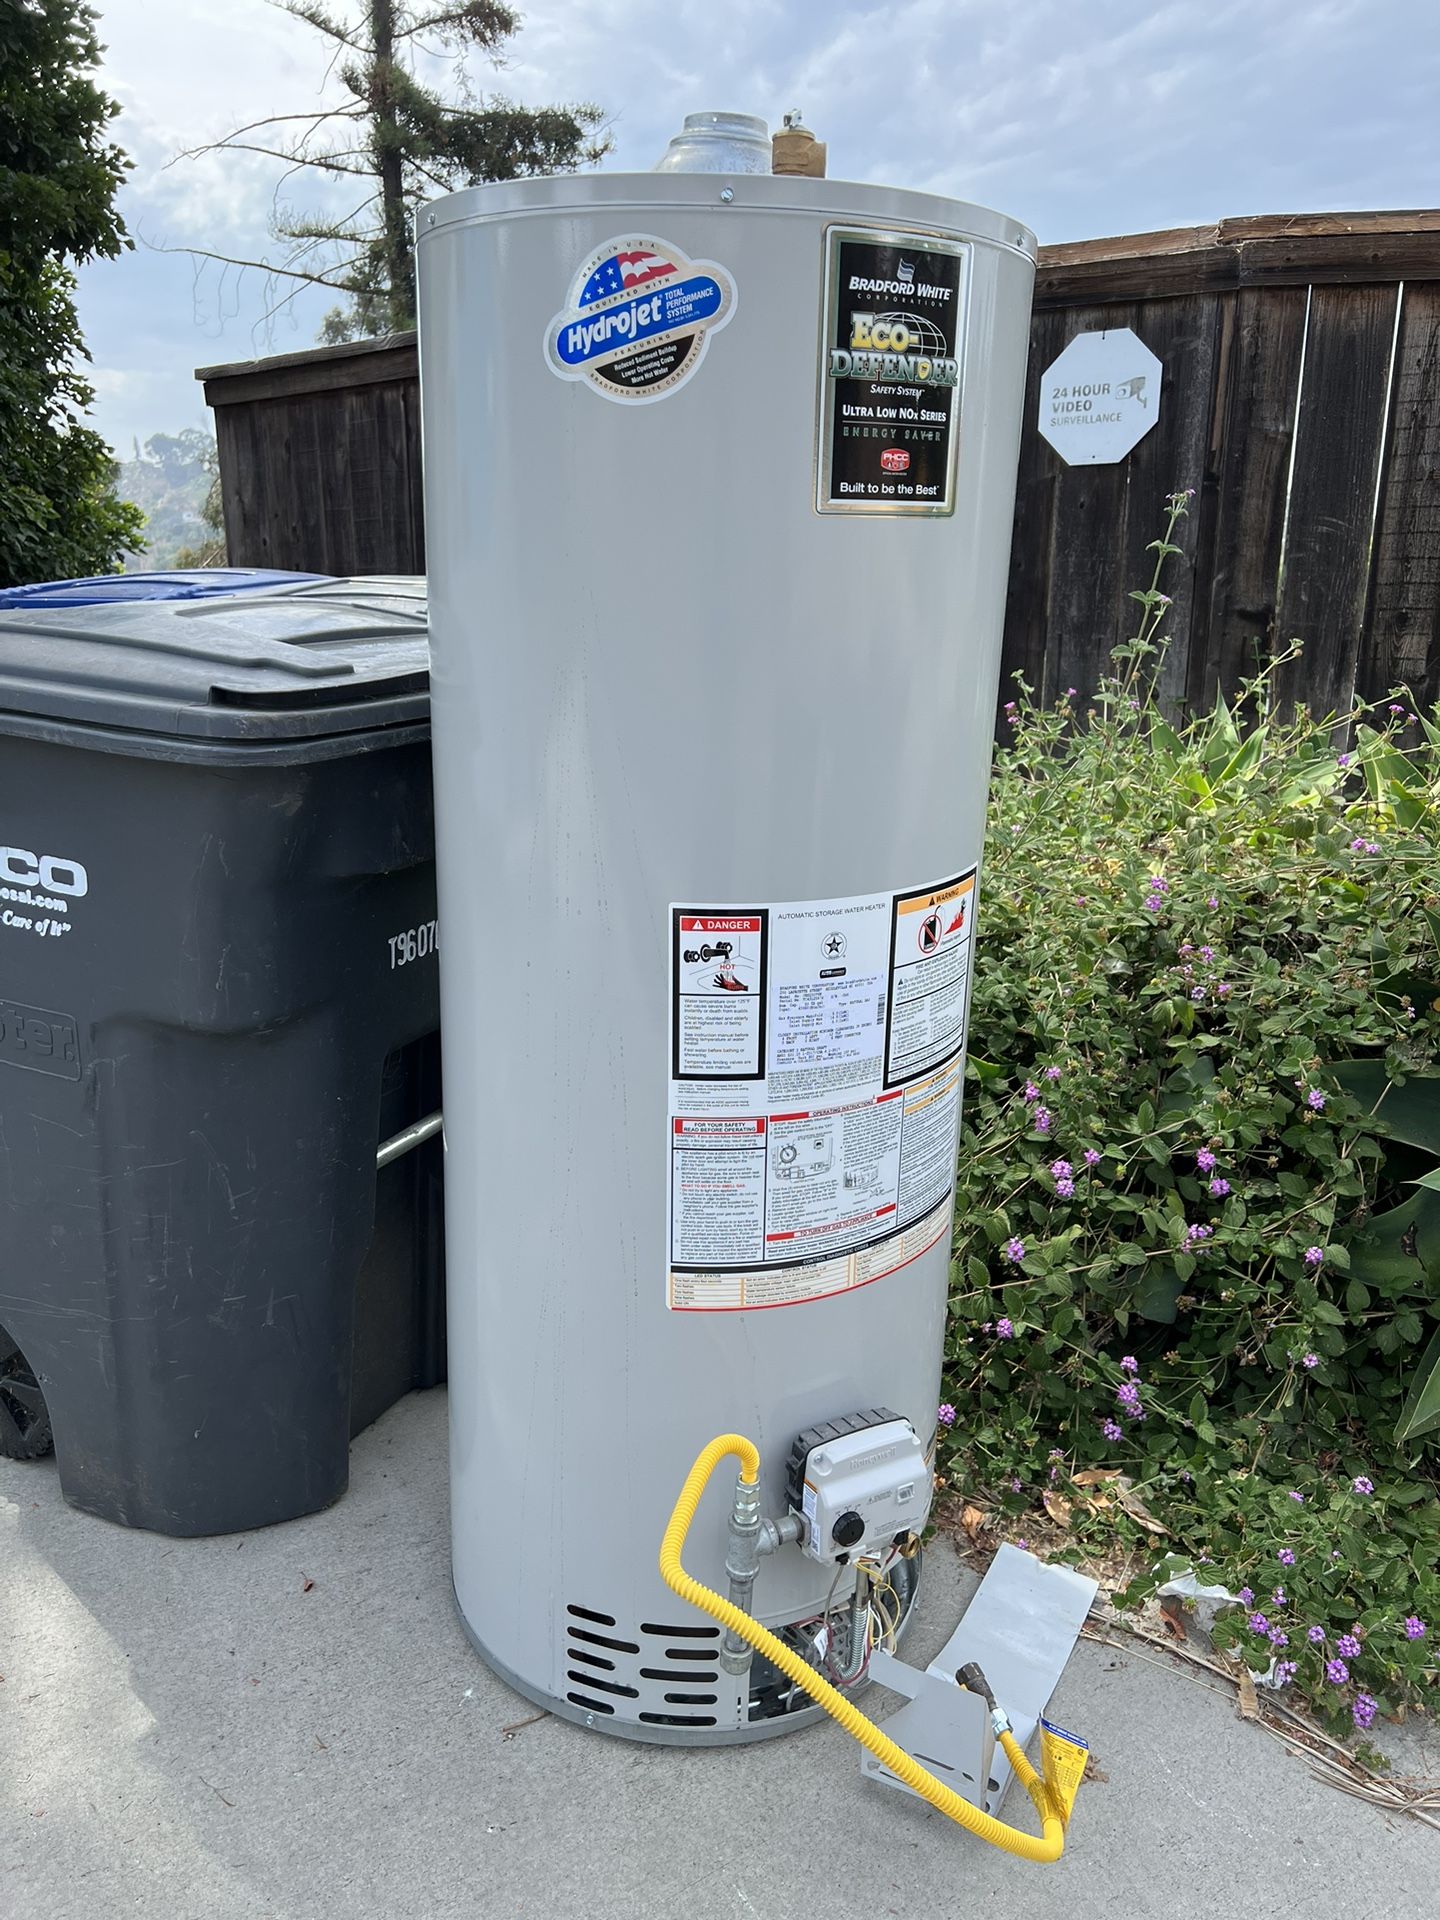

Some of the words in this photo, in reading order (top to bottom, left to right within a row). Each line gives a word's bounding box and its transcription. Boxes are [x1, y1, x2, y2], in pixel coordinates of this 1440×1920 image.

[589, 289, 638, 311] EQUIPPED
[645, 278, 670, 289] WITH
[665, 288, 684, 300] TOTAL
[849, 276, 915, 295] BRADFORD
[917, 283, 951, 300] WHITE
[666, 287, 714, 310] PERFORMANCE
[858, 294, 943, 307] CORPORATION
[666, 304, 693, 318] SYSTEM
[568, 295, 661, 354] Hydrojet
[615, 334, 670, 356] FEATURING
[591, 373, 630, 395] BRADFORD
[636, 385, 661, 395] WHITE
[666, 330, 704, 385] CORPORATION
[661, 356, 674, 364] Costs
[830, 347, 958, 387] DEFENDER
[631, 375, 644, 383] More
[870, 384, 896, 394] SAFETY
[1052, 387, 1068, 399] 24
[1072, 383, 1111, 397] HOUR
[842, 405, 873, 417] ULTRA
[877, 406, 897, 418] LOW
[920, 409, 946, 421] SERIES
[1052, 401, 1092, 413] VIDEO
[1051, 413, 1122, 427] SURVEILLANCE
[843, 427, 897, 438] ENERGY
[905, 429, 940, 441] SAVER
[840, 482, 865, 493] Built
[868, 484, 879, 493] to
[882, 483, 895, 494] be
[898, 484, 913, 494] the
[916, 485, 937, 495] Best
[0, 887, 67, 912] osal.com
[778, 911, 814, 919] AUTOMATIC
[815, 909, 843, 917] STORAGE
[865, 903, 885, 911] HEATER
[3, 910, 32, 930] Care
[35, 918, 50, 936] of
[708, 921, 750, 929] DANGER
